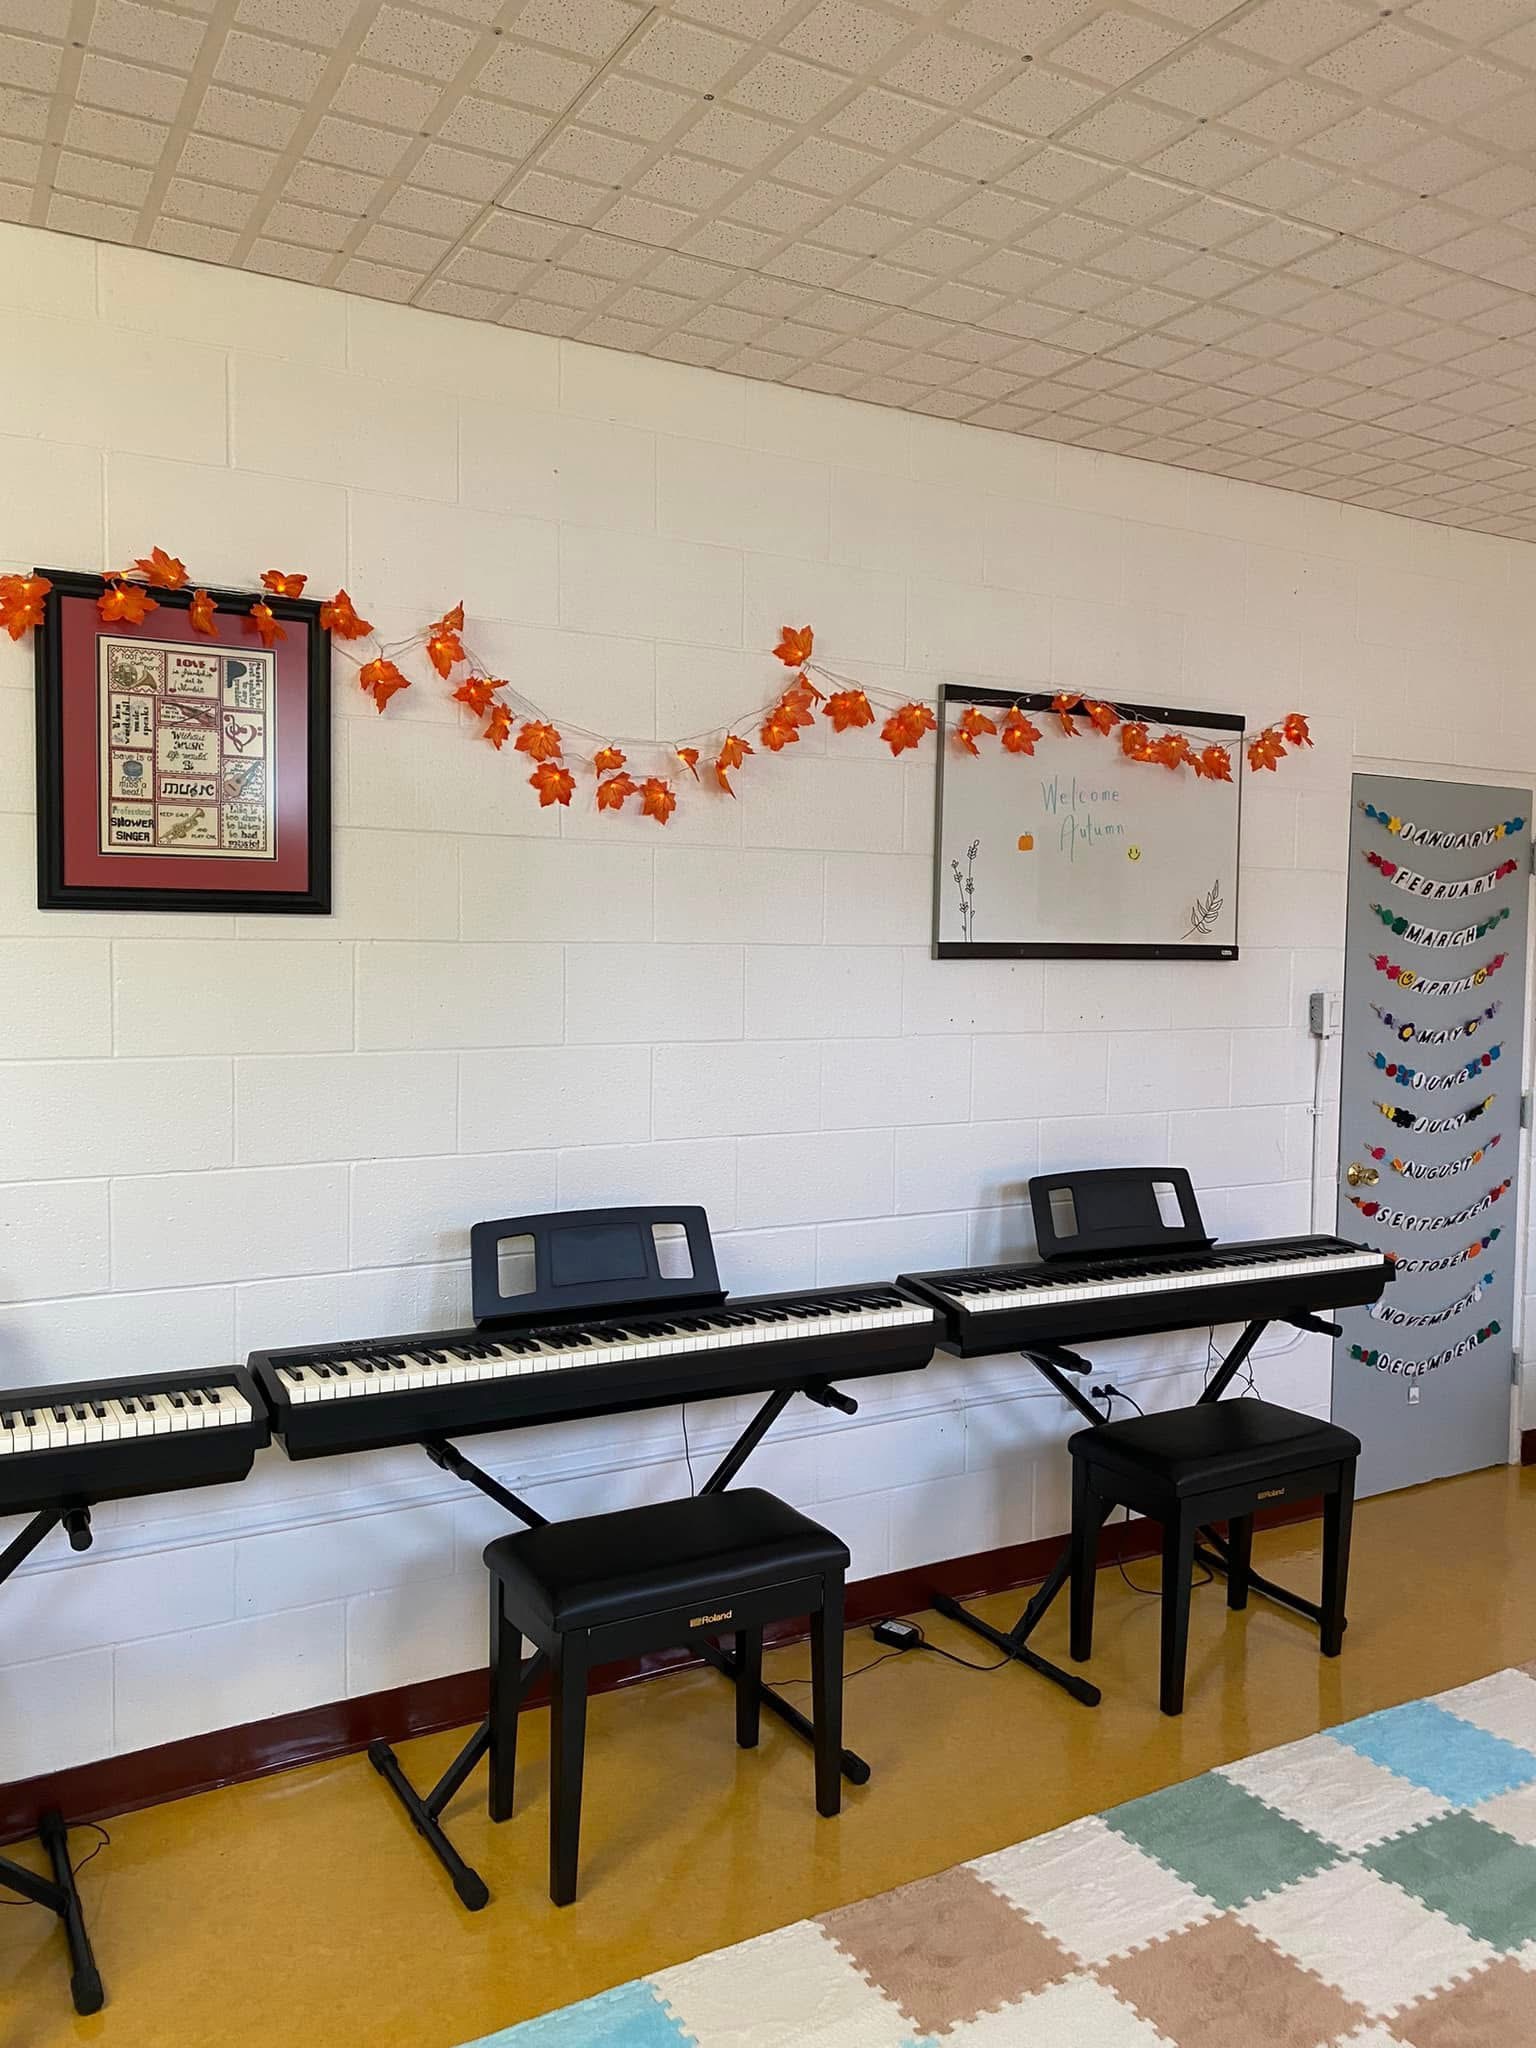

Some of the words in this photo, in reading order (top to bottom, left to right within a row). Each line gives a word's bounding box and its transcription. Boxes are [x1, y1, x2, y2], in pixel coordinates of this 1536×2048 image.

[112, 704, 121, 729] When
[141, 706, 152, 735] speaks
[171, 731, 205, 741] Without
[1040, 775, 1120, 814] Welcome
[111, 817, 154, 829] SHOWER
[116, 831, 150, 842] SINGER
[1061, 813, 1125, 863] Autumn
[1402, 825, 1494, 849] JANUARY
[1395, 870, 1495, 899] FEBRUARY
[1406, 925, 1476, 947] MARCH
[1412, 979, 1471, 995] APRIL
[1419, 1026, 1463, 1045] MAY
[1415, 1070, 1467, 1090] JUNE
[1415, 1114, 1466, 1133] JULY
[1403, 1157, 1473, 1180] AUGUST
[1377, 1196, 1491, 1231] SEPTEMBER
[1395, 1251, 1471, 1272] OCTOBER
[1380, 1295, 1475, 1327] NOVEMBER
[1378, 1335, 1477, 1376] DECEMBER
[702, 1610, 732, 1624] Roland
